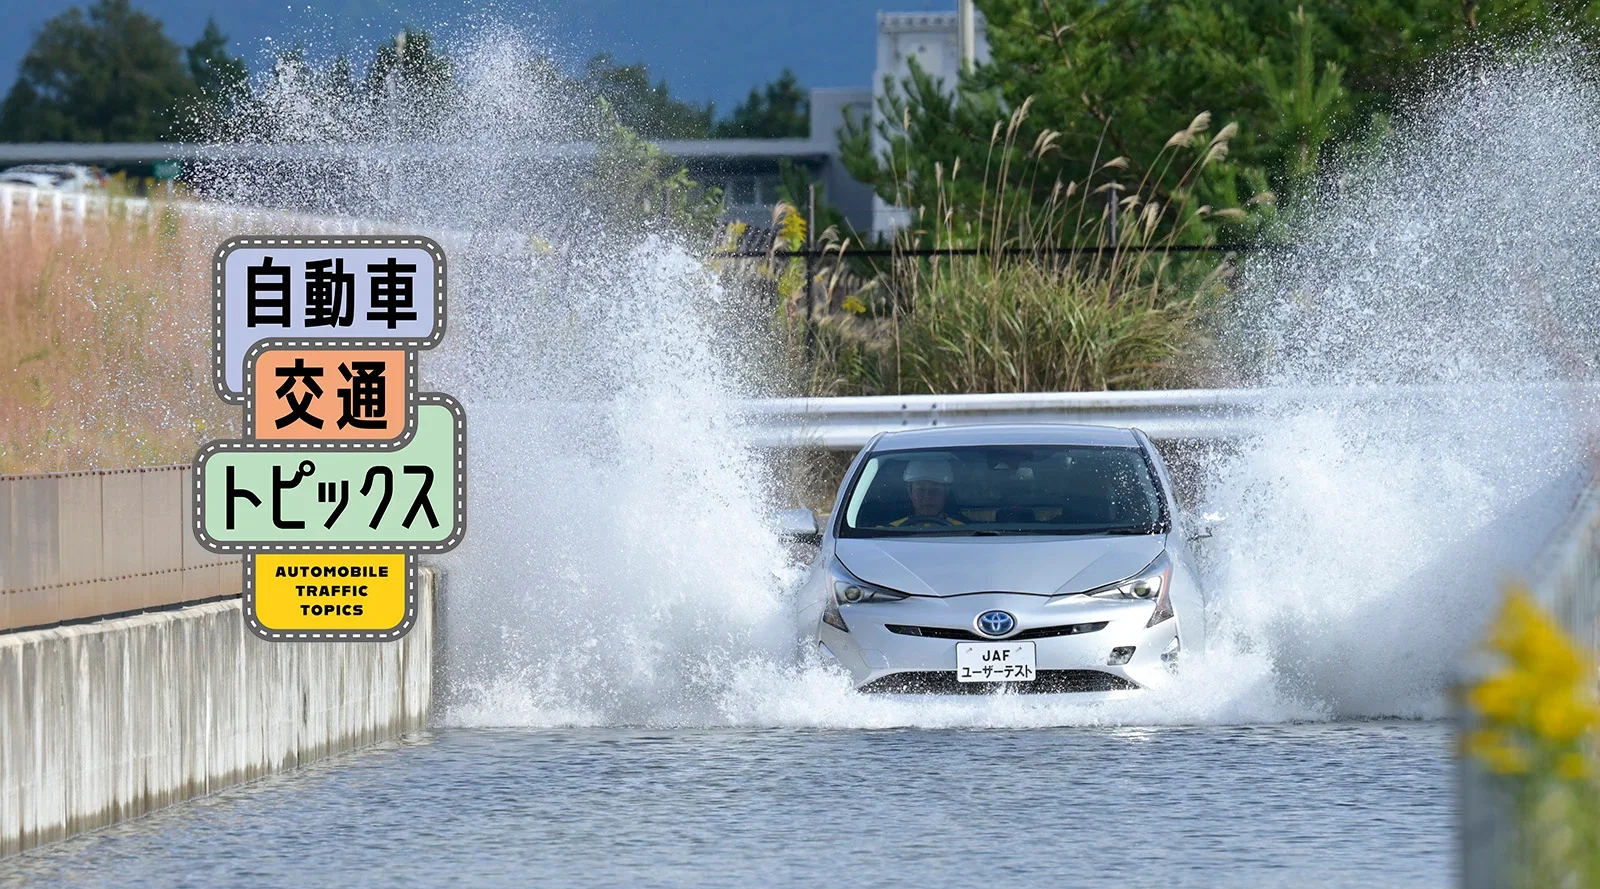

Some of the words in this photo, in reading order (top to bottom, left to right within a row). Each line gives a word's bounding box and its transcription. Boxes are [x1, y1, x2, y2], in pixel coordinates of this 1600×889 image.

[982, 649, 1011, 662] JAF
[961, 664, 1033, 679] ユーザーテスト
